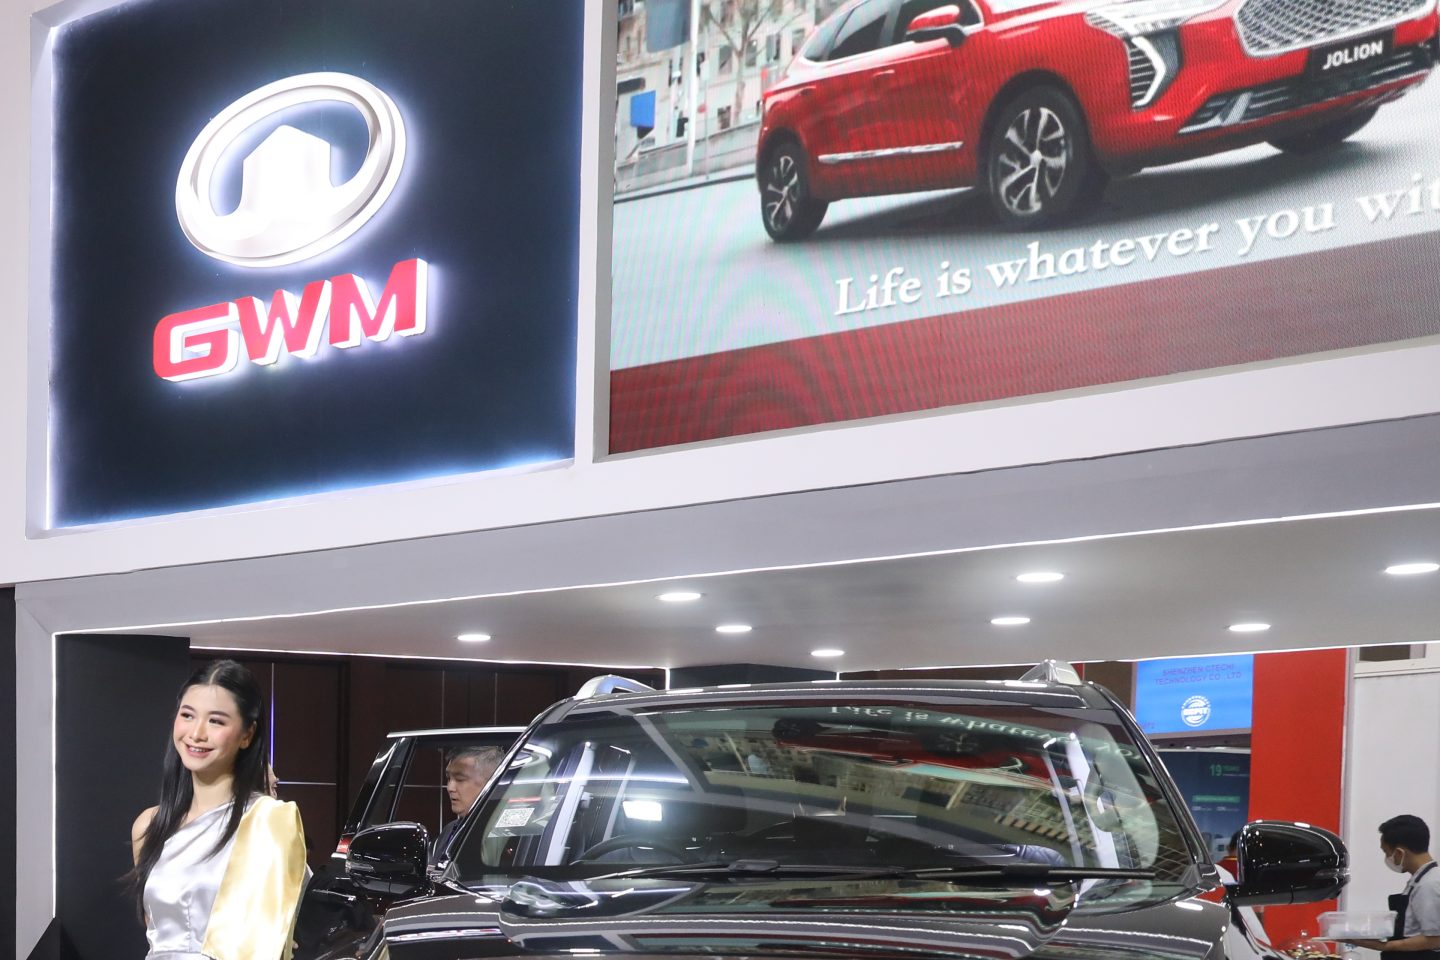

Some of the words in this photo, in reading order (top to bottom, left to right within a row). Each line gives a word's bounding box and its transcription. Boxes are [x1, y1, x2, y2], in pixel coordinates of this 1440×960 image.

[1322, 40, 1384, 70] JOLION
[833, 264, 923, 316] Life
[935, 261, 972, 297] is
[985, 222, 1220, 289] whatever
[1235, 202, 1337, 255] you
[152, 257, 429, 383] GWM
